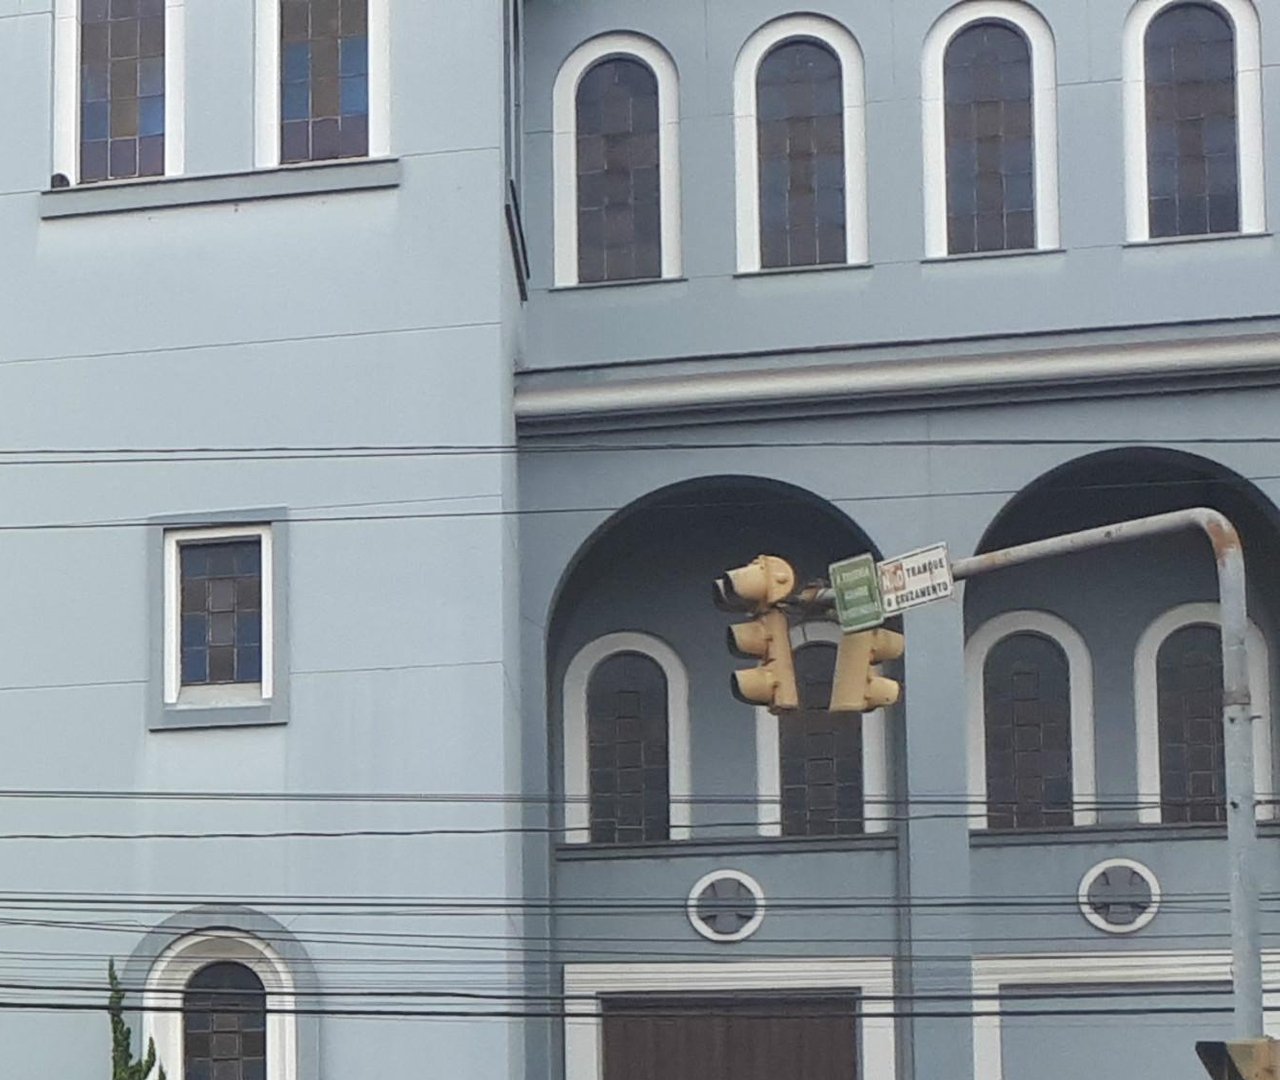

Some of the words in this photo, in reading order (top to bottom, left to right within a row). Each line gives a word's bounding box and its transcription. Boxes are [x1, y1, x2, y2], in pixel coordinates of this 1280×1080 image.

[881, 567, 904, 591] NO
[906, 558, 944, 578] TRANQUE
[895, 582, 948, 606] CRUZAMENTO
